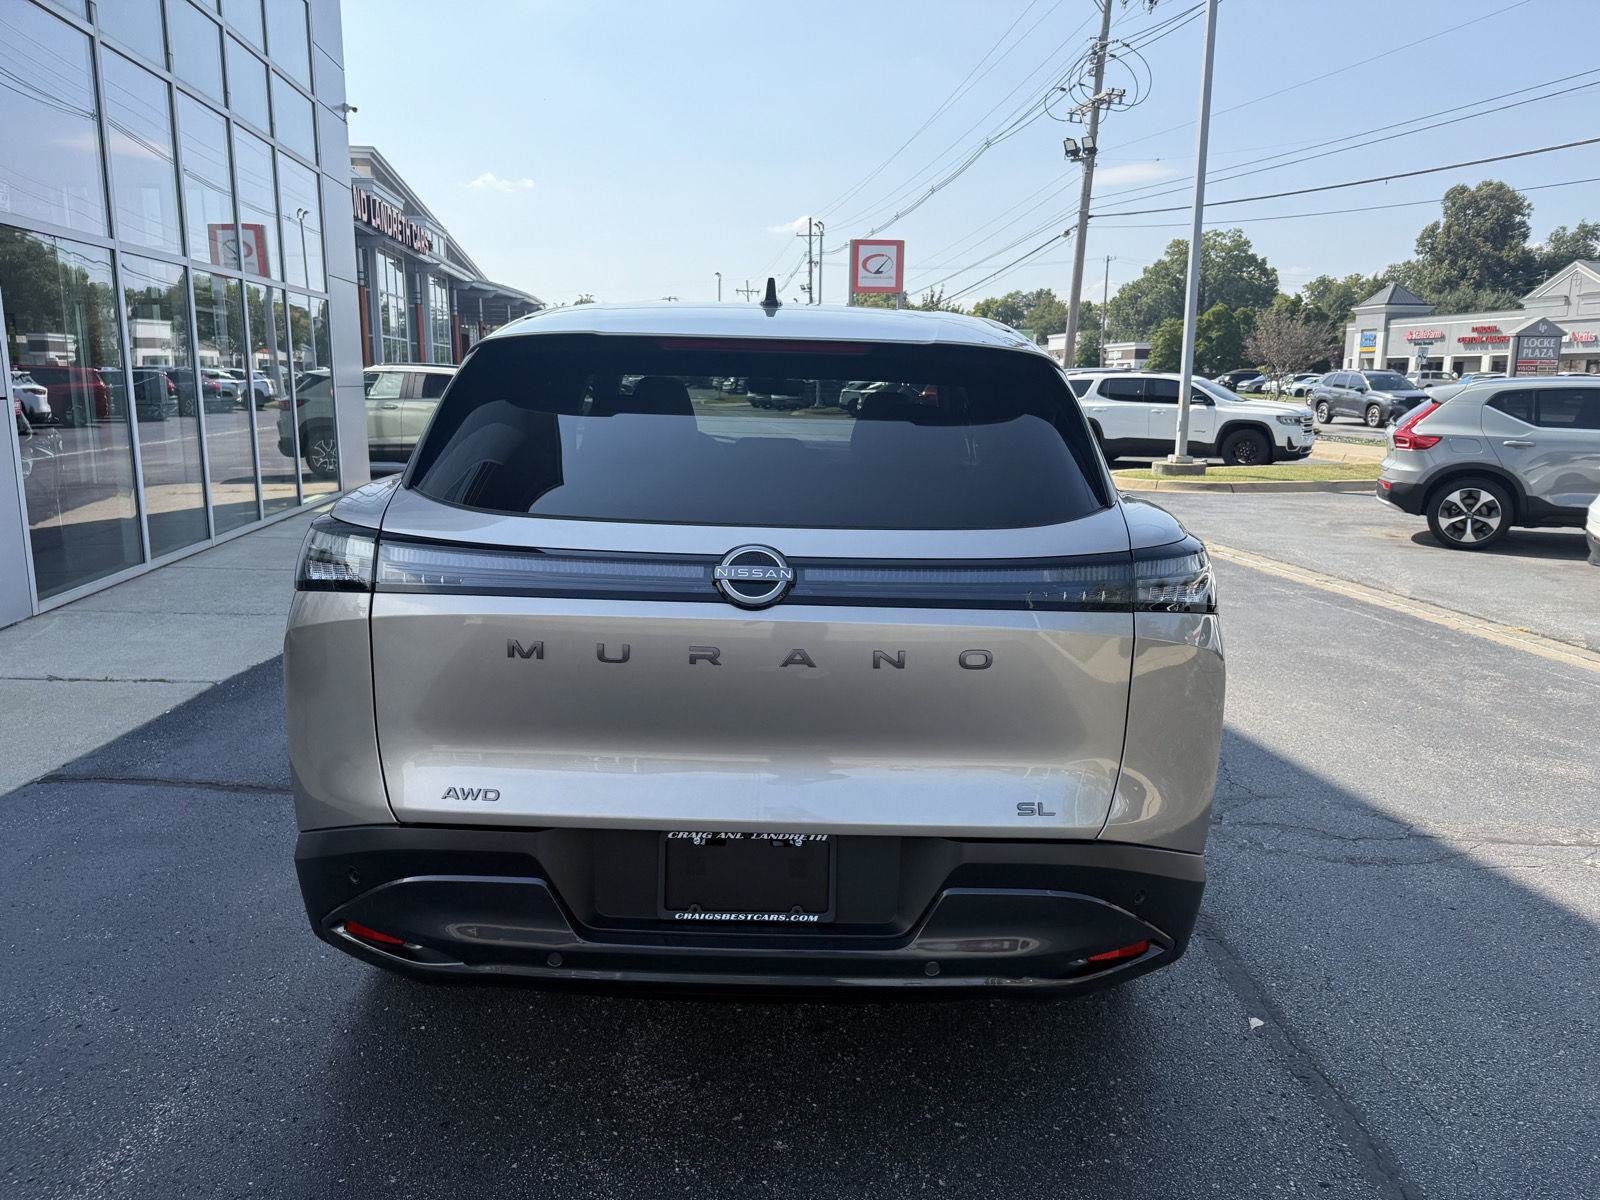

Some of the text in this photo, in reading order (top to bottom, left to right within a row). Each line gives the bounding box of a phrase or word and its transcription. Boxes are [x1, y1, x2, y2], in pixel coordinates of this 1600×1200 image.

[371, 196, 412, 246] LANDRETH
[412, 222, 429, 255] CARS
[1571, 330, 1595, 343] Nails
[1523, 338, 1556, 348] LOCKE
[1522, 348, 1554, 358] PLAZA
[716, 568, 792, 579] NISSAN
[506, 638, 994, 671] MURANO
[441, 786, 501, 802] AWD
[1016, 801, 1056, 817] SL
[667, 831, 713, 839] CRAIG
[751, 833, 828, 841] LANDRETH
[675, 912, 819, 923] CRAIGSBESTCARS.COM
